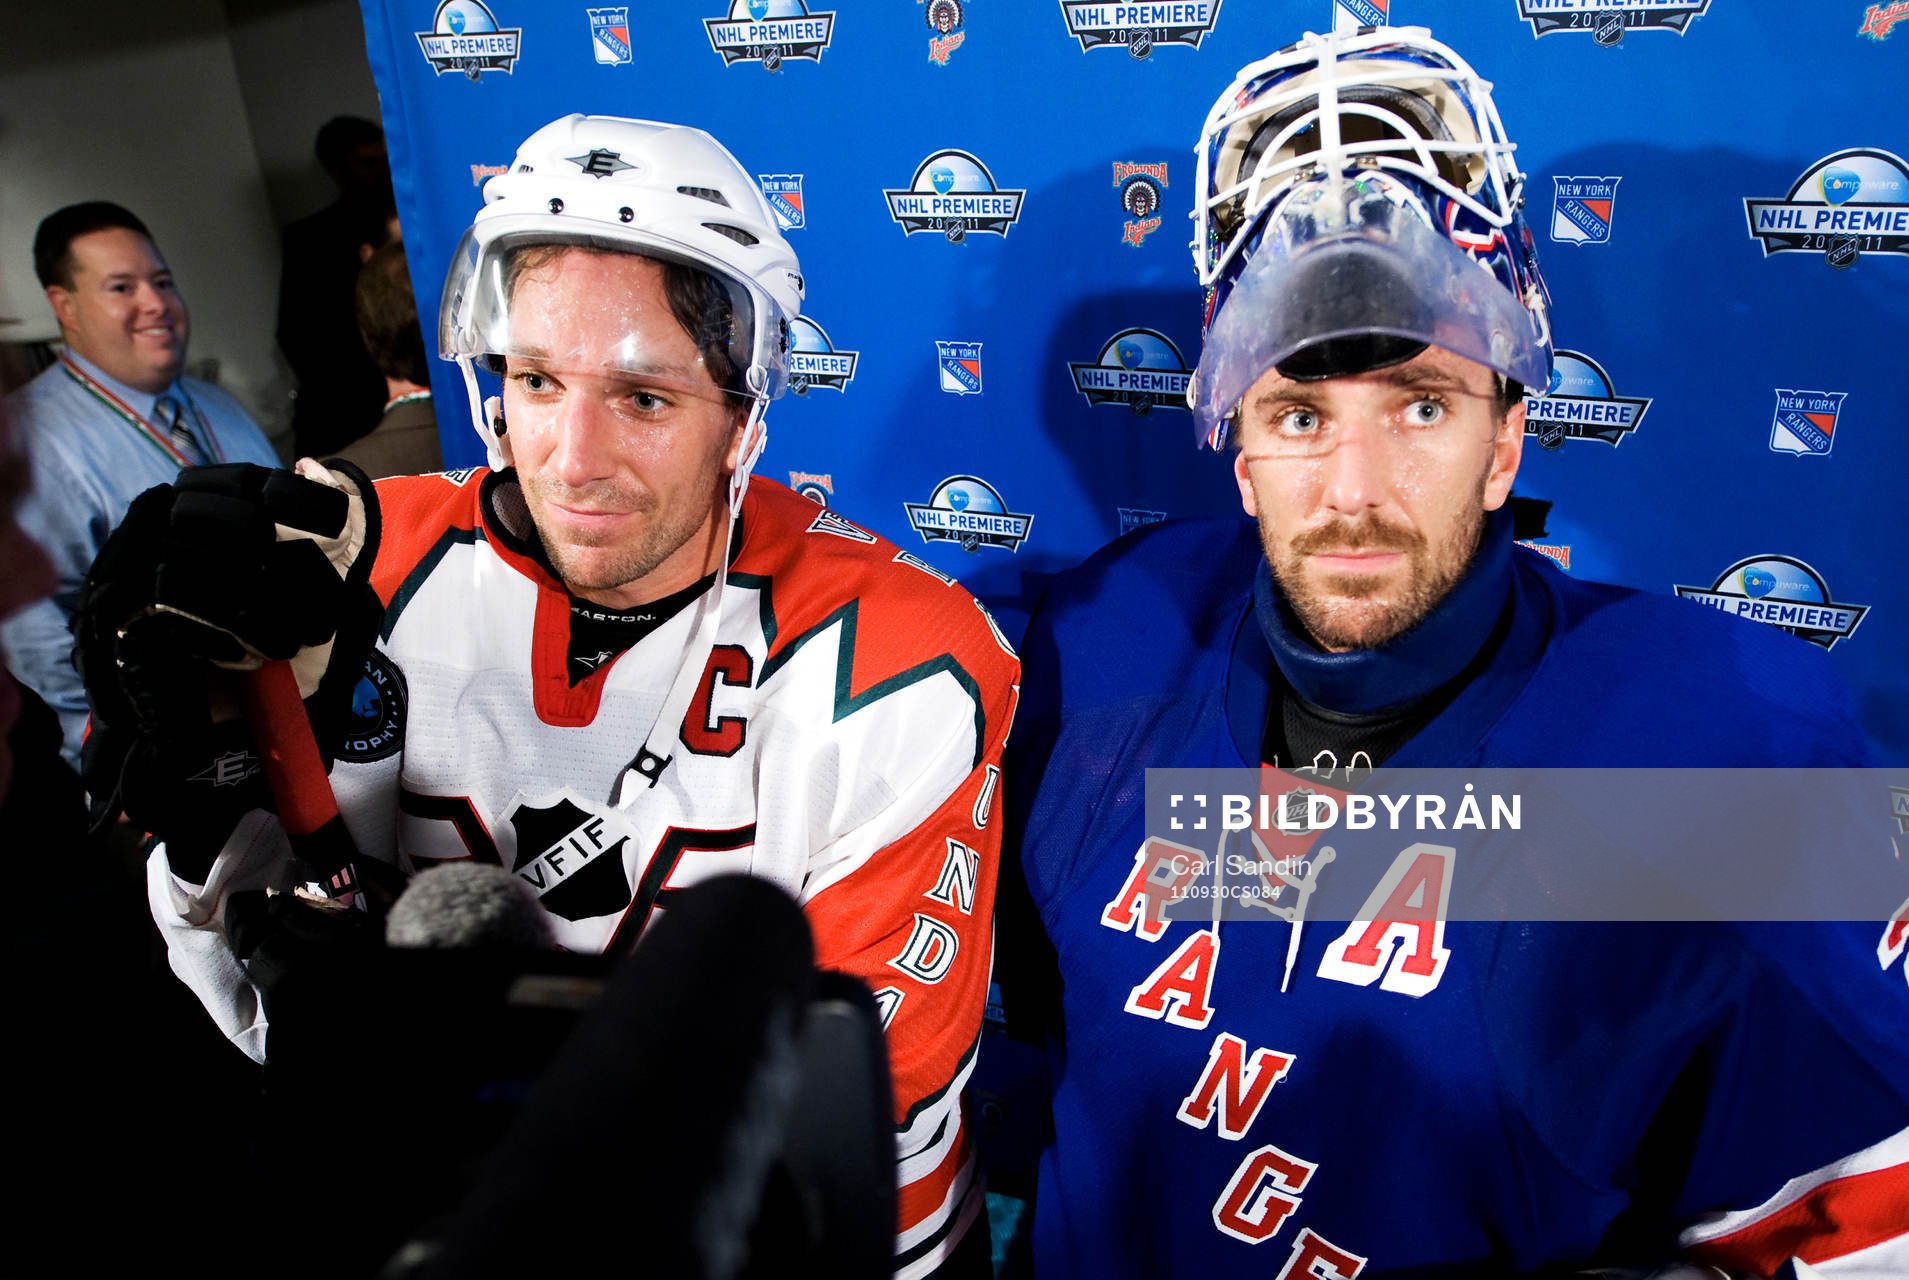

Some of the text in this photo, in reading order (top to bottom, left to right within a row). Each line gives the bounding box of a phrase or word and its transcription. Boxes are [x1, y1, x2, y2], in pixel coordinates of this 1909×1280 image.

[1075, 4, 1208, 26] NHL PREMIERE
[1343, 0, 1384, 26] ANGERS
[717, 22, 824, 43] NHL PREMIERE
[427, 38, 513, 54] NHL PREMIERE
[1558, 184, 1612, 196] NEW YORK
[897, 199, 1012, 214] NHL PREMIERE
[1564, 199, 1605, 238] RANGERS
[1759, 209, 1807, 229] NHL
[1832, 242, 1853, 261] NHL
[941, 347, 978, 358] NEW YORK
[790, 356, 847, 373] REMIERE
[947, 359, 978, 390] RANGERS
[1082, 371, 1190, 391] NHL PREMIER
[1526, 400, 1632, 423] PREMIERE
[1780, 397, 1836, 411] NEW YORK
[1785, 412, 1827, 450] RANGERS
[917, 512, 1022, 534] NHL PREMIERE
[1737, 600, 1849, 628] PREMIERE
[679, 644, 753, 757] C
[520, 816, 605, 890] VFIF
[1316, 842, 1456, 999] A
